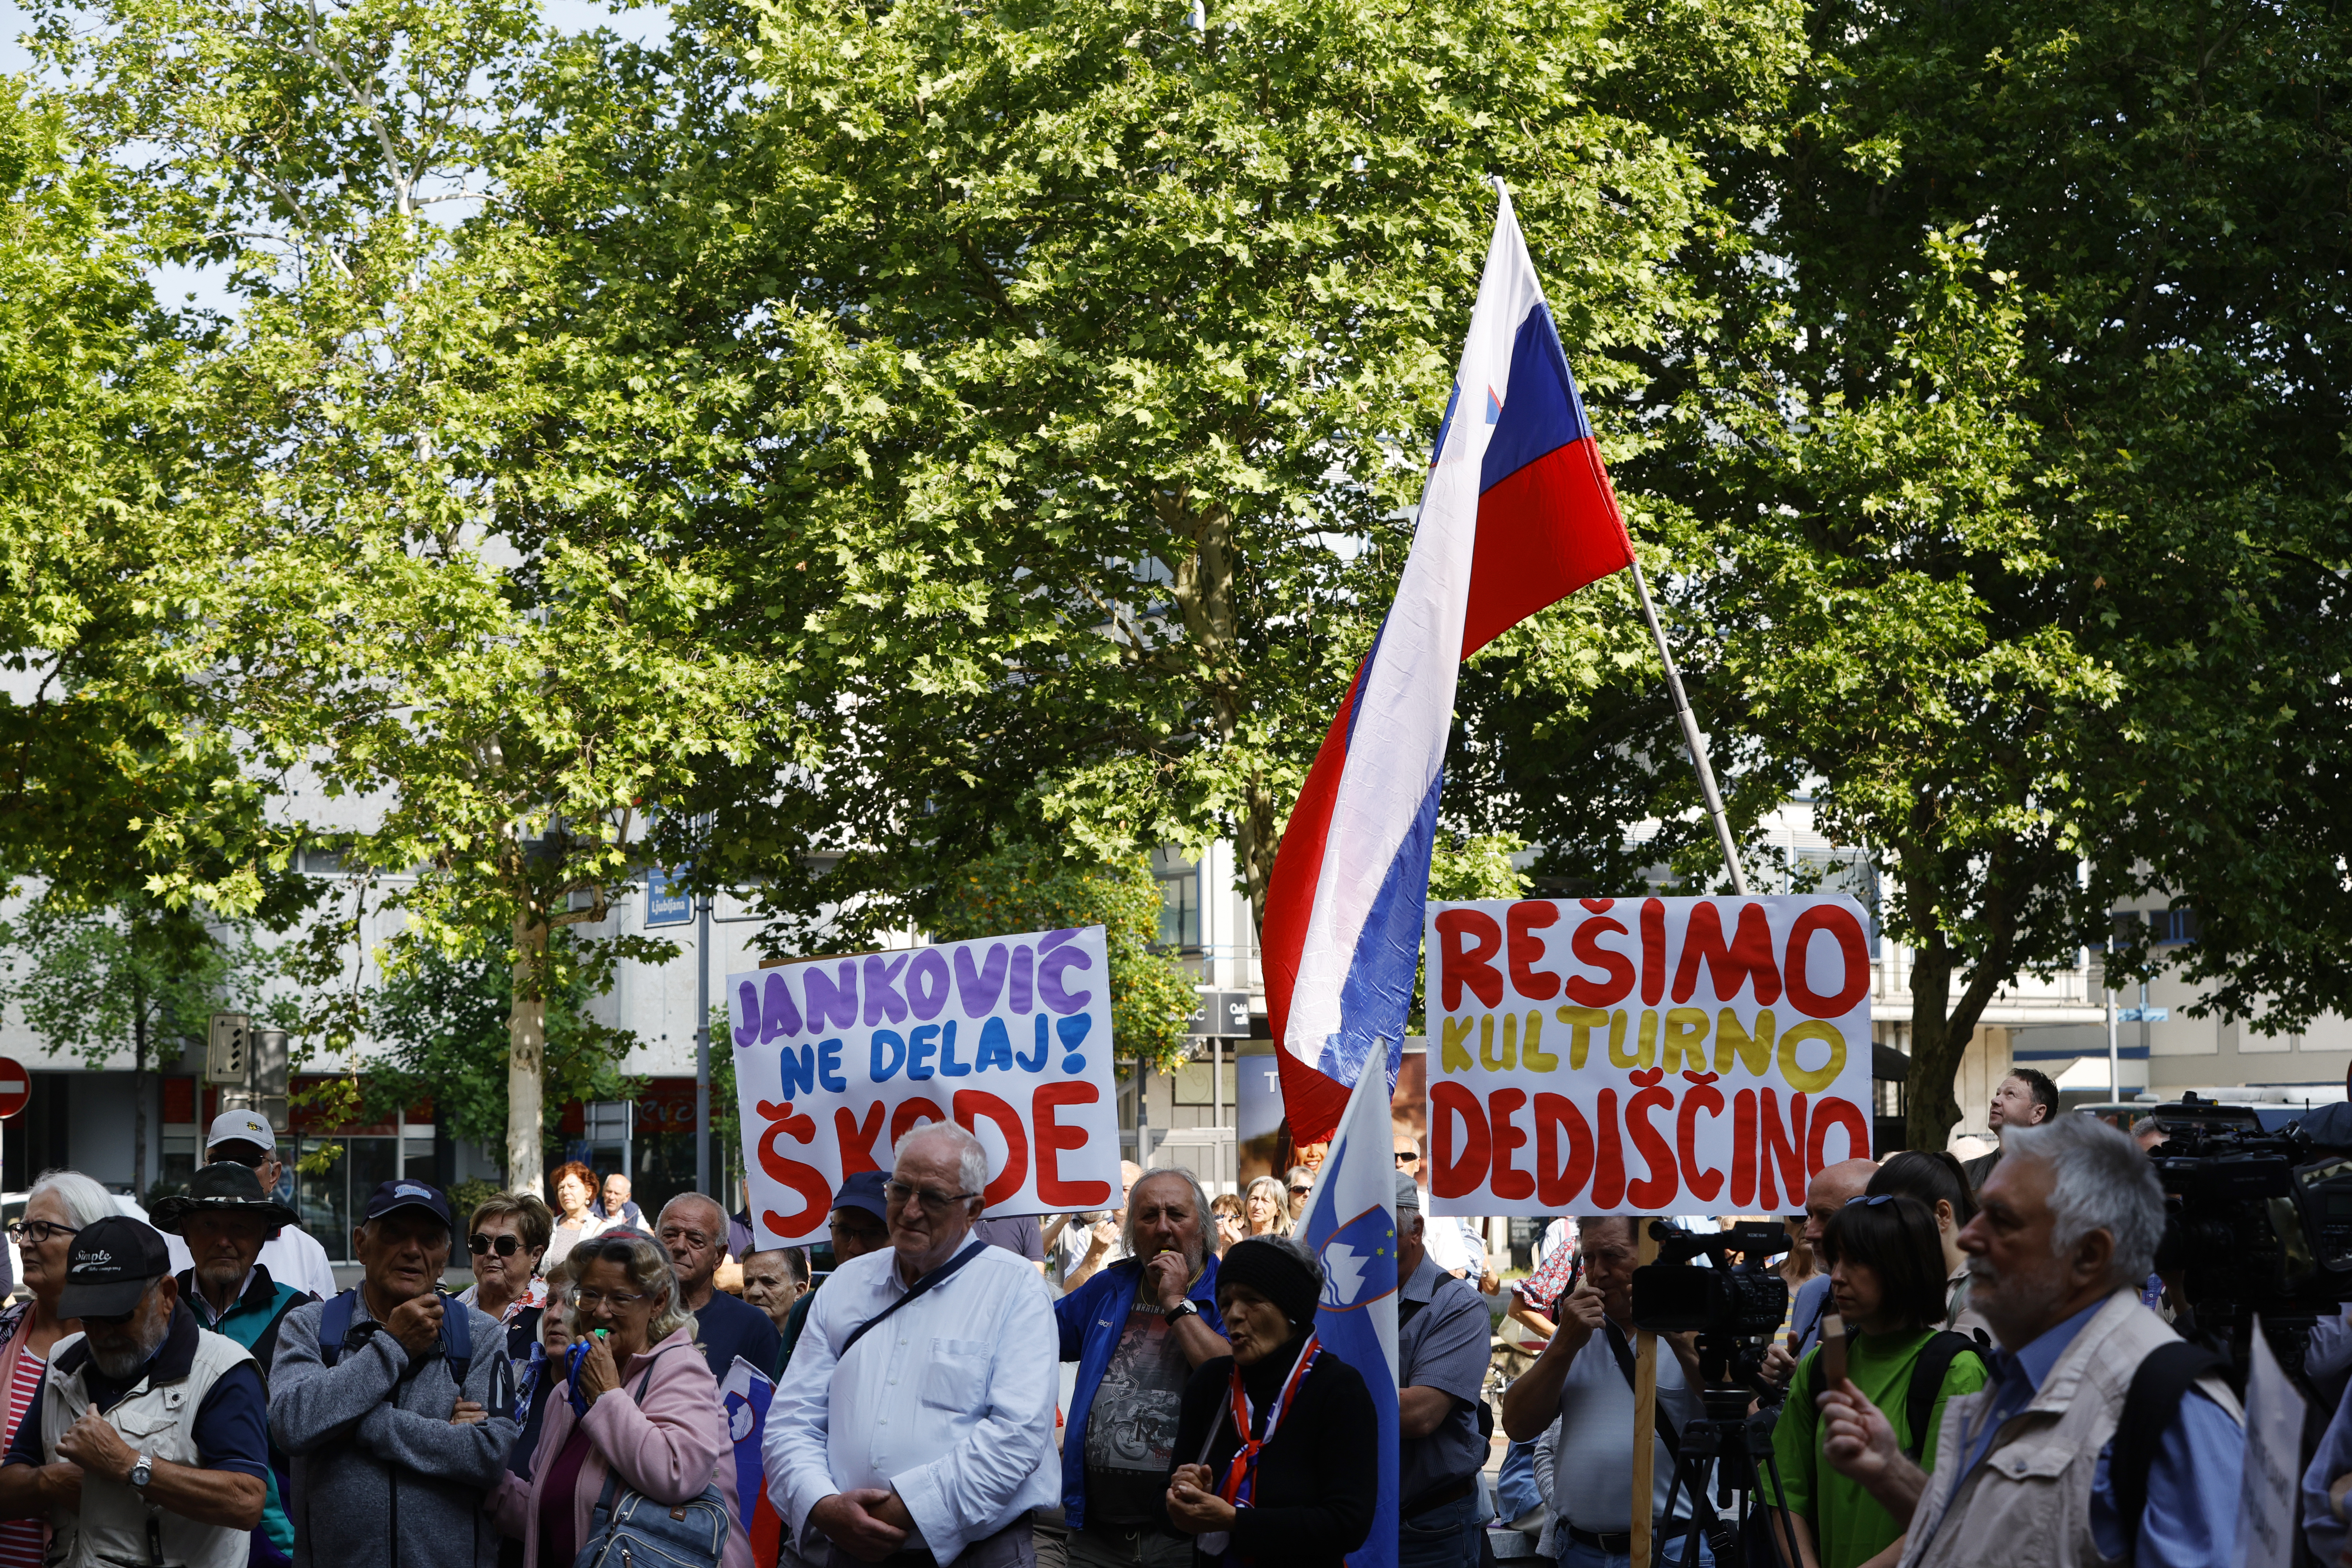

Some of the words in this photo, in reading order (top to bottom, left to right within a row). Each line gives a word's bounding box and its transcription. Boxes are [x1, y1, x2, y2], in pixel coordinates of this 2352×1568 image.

[652, 898, 686, 915] Ljubljana
[734, 928, 1092, 1048] JANKOVIĆ
[1435, 898, 1870, 1019] REŠIMO
[780, 1038, 847, 1101] NE
[870, 1013, 1092, 1083] DELAJ!
[1442, 1005, 1847, 1094] KULTURNO
[1430, 1067, 1869, 1211] DEDIŠČINO
[75, 1250, 112, 1263] Simple
[1136, 1303, 1160, 1314] WRATH
